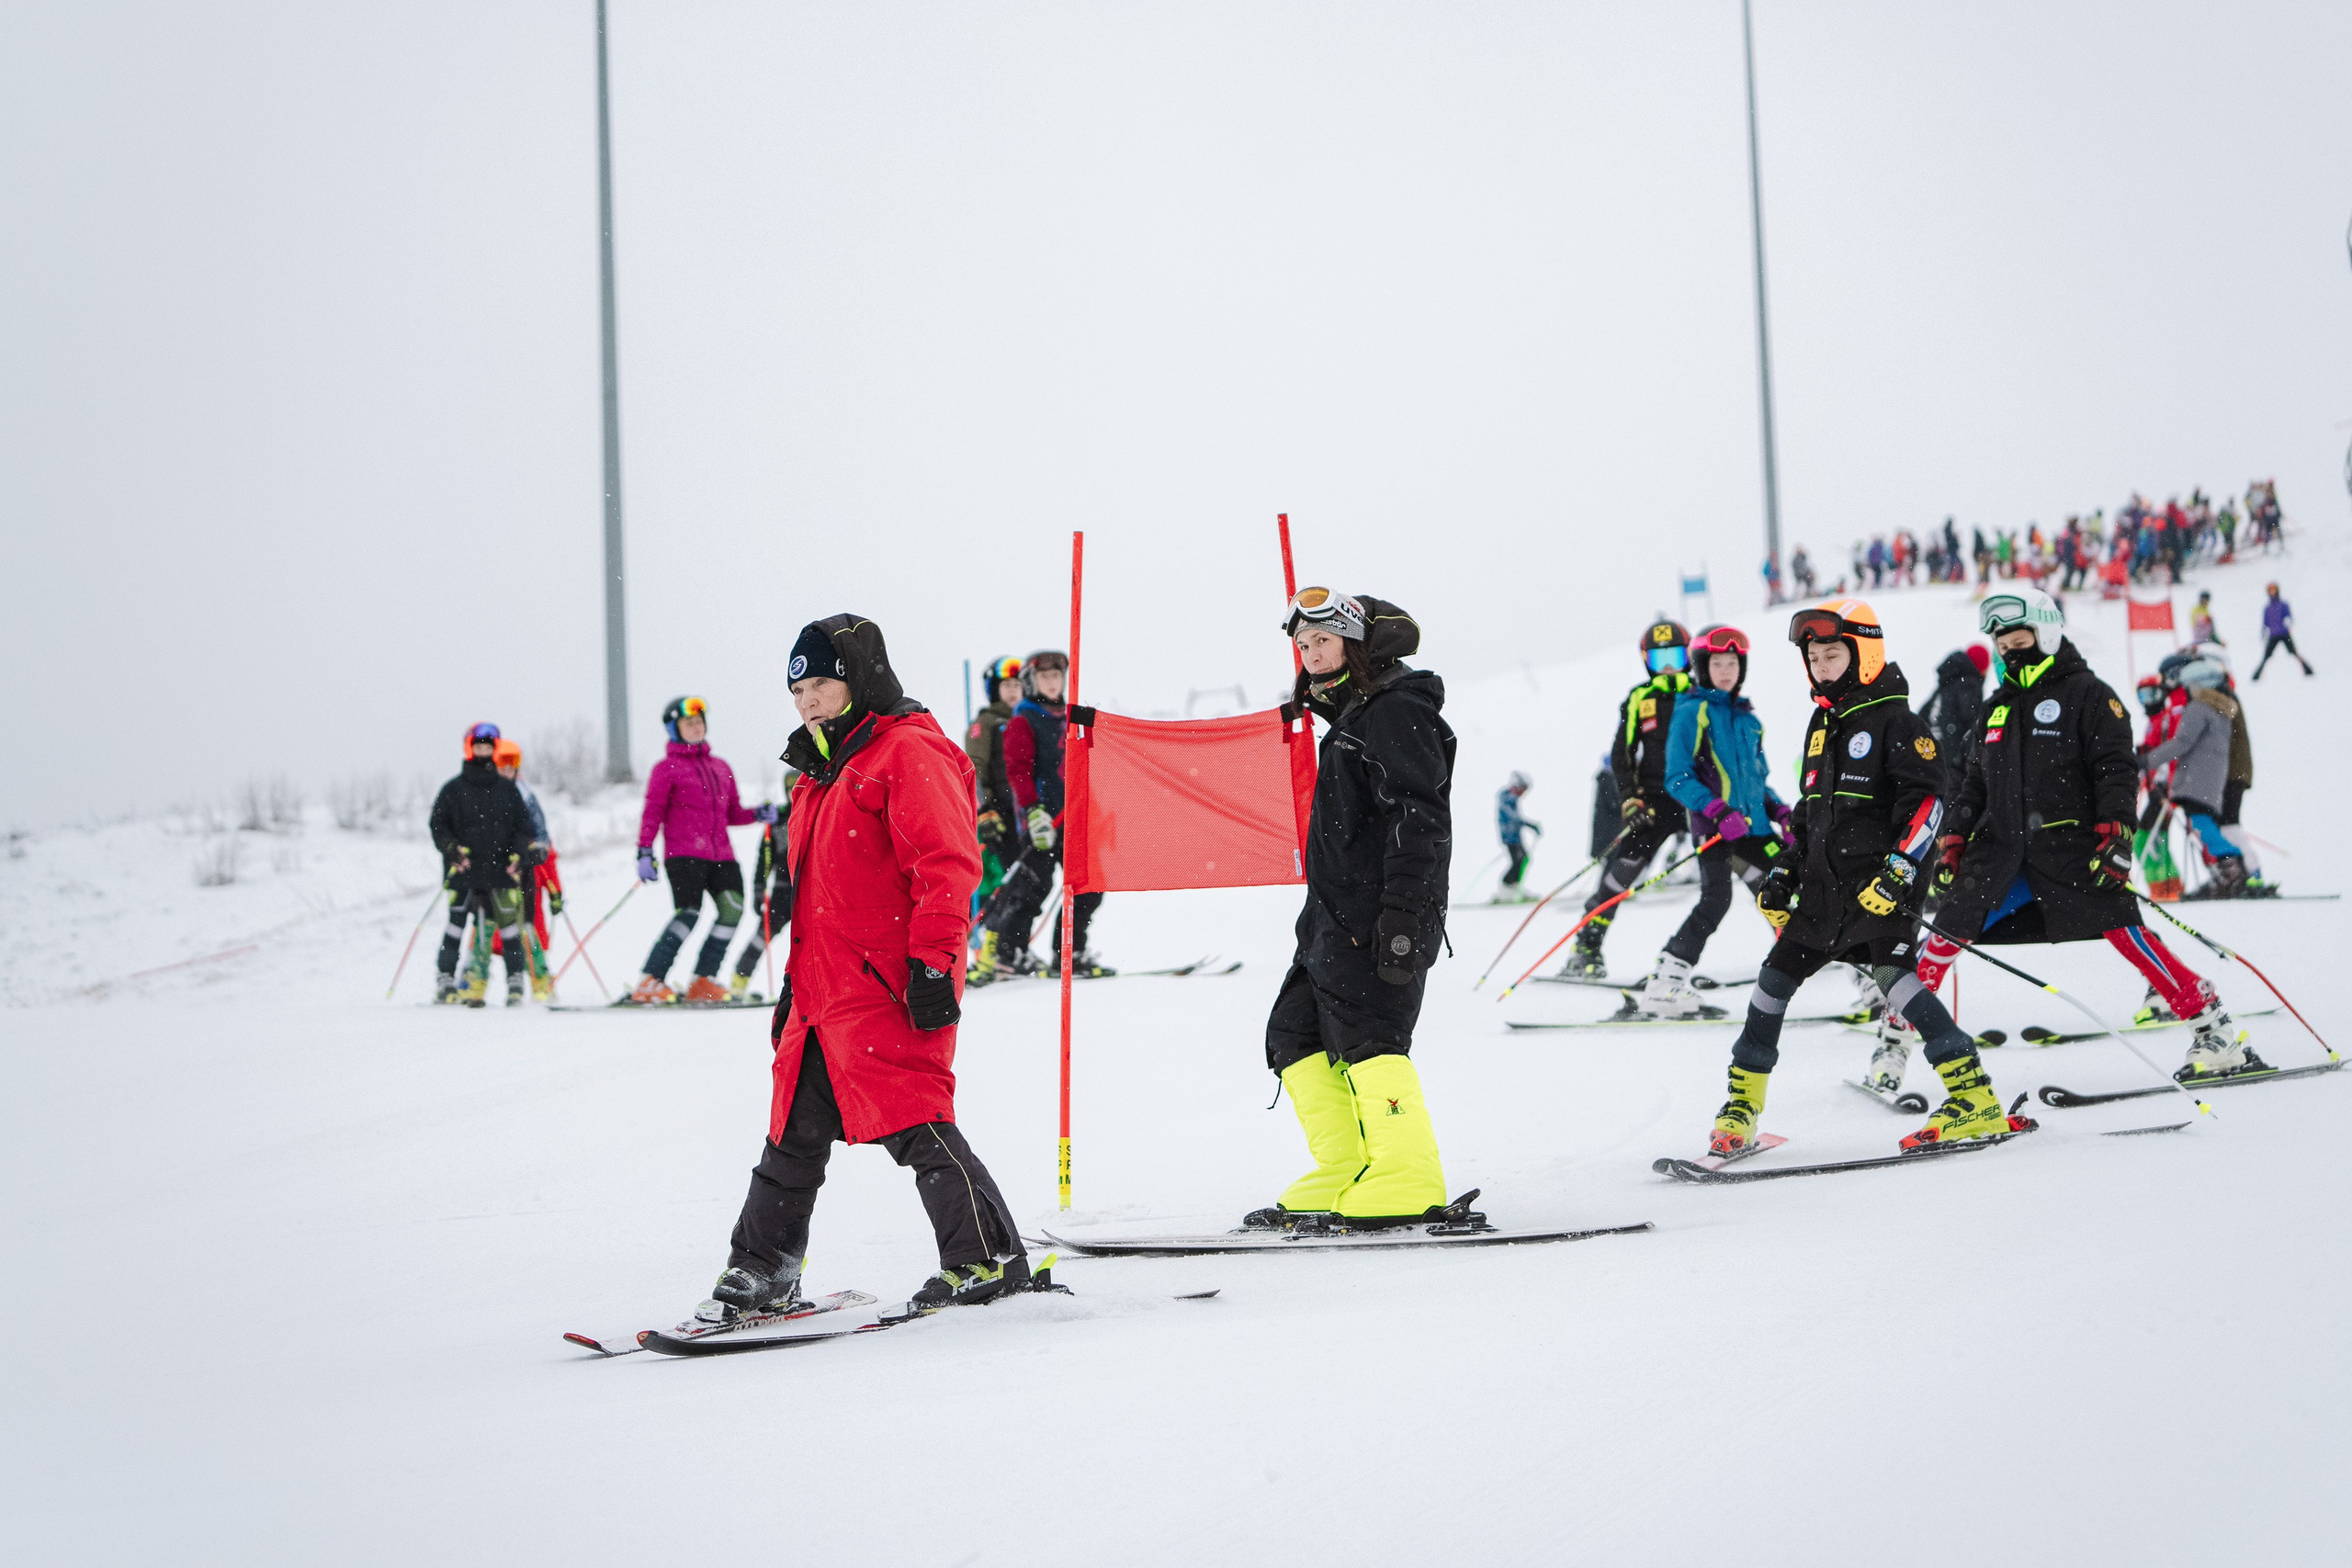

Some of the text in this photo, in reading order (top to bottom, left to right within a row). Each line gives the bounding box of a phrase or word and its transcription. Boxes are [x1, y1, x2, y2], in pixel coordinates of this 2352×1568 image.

[1340, 602, 1364, 625] uve
[1320, 618, 1347, 630] isbär
[1845, 774, 1871, 783] SCOTT
[1876, 885, 1893, 900] LEVEL
[1941, 1103, 2001, 1134] FISCHER
